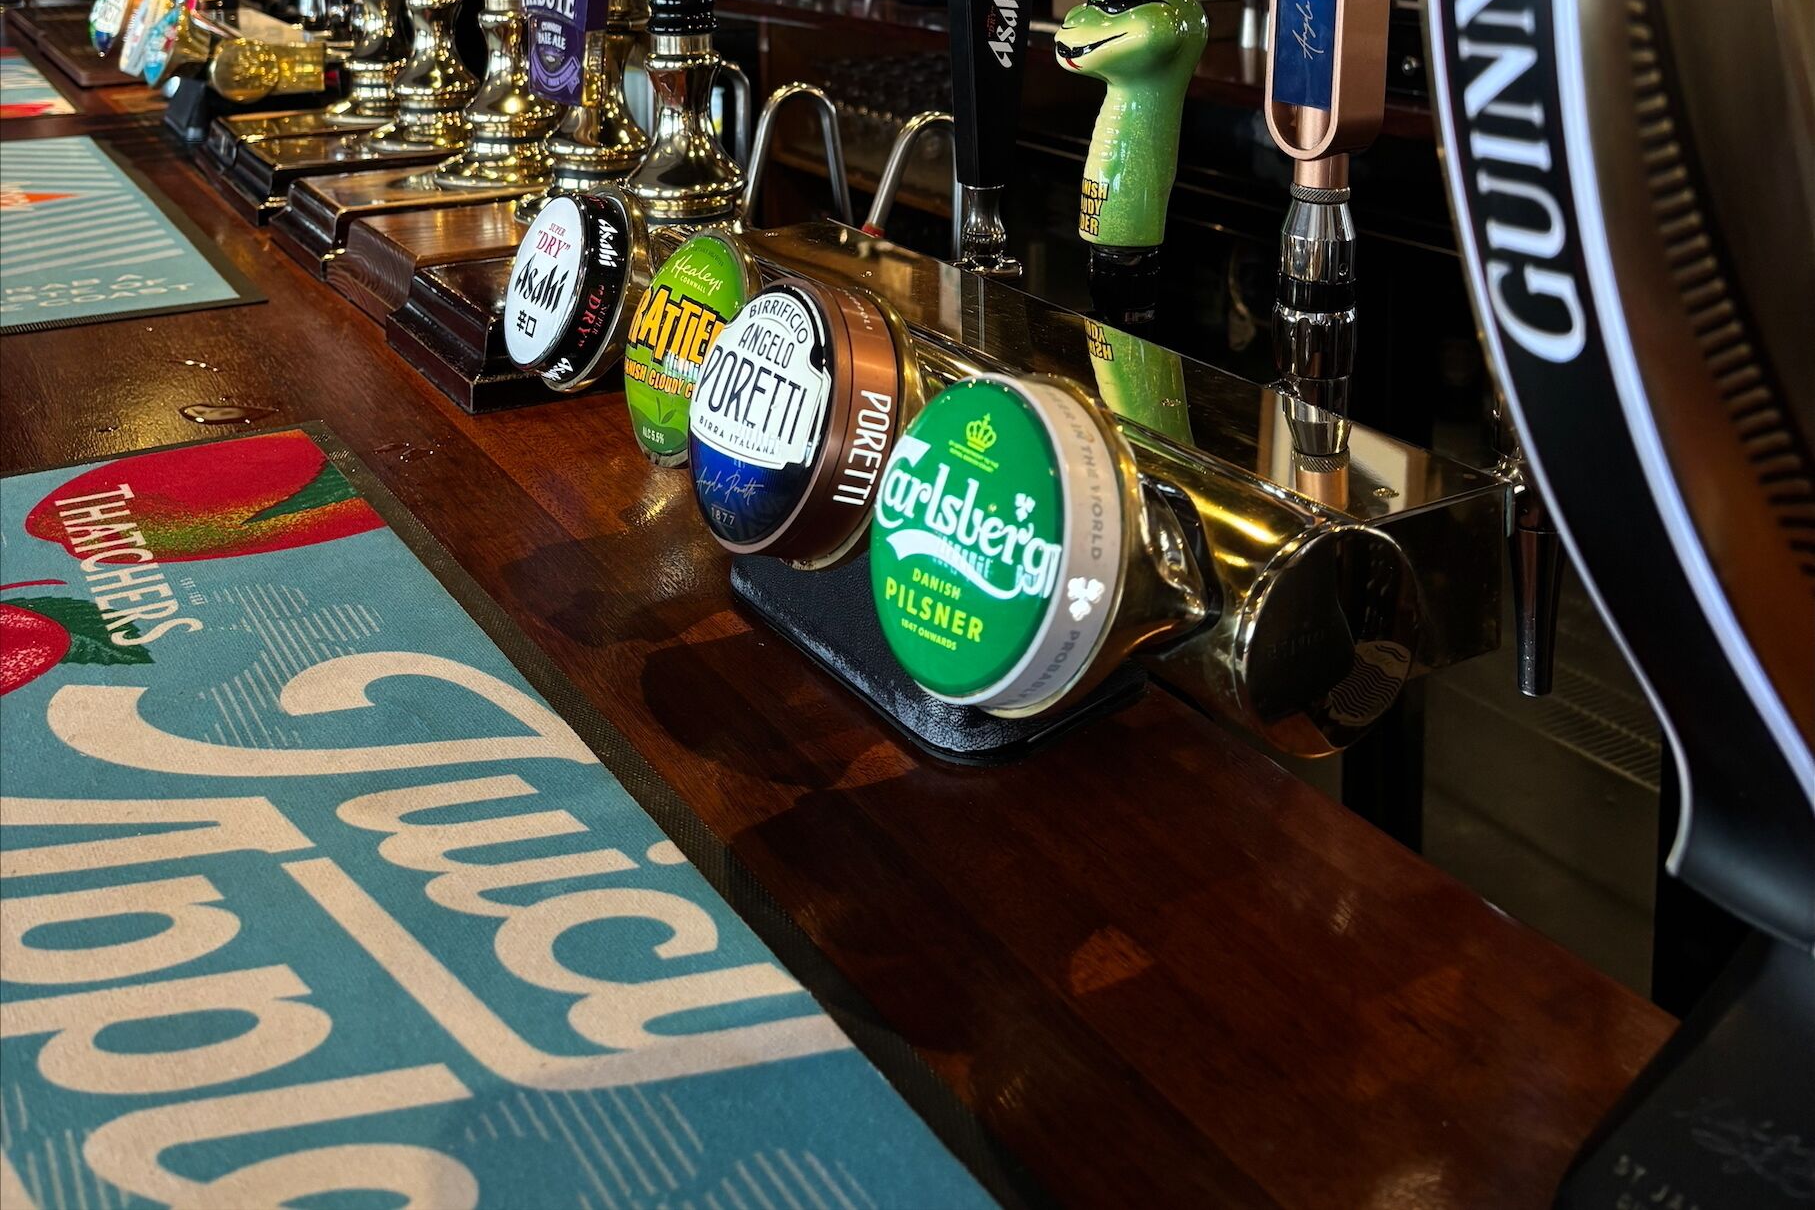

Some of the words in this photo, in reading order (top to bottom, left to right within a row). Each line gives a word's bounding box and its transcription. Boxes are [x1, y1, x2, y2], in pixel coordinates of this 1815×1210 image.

[598, 218, 619, 268] Asahi
[38, 282, 195, 308] COAST
[514, 252, 570, 314] Asahi
[670, 253, 724, 297] Healeys
[680, 275, 707, 294] CORNWALL
[738, 321, 795, 370] ANGELO
[749, 299, 809, 344] BIRRIFICIO
[648, 369, 685, 395] CLOUDY
[698, 344, 808, 446] PORETTI
[699, 415, 725, 439] BIRRA
[729, 433, 776, 456] ITALIANA
[832, 390, 893, 506] PORETTI
[710, 506, 736, 526] 1877
[875, 435, 1062, 599] Carlsberg
[1081, 445, 1099, 481] THE
[1090, 485, 1104, 561] WORLD
[54, 481, 205, 649] THATCHERS
[912, 567, 961, 601] DANISH
[885, 576, 984, 643] PILSNER
[917, 626, 957, 651] ONWARDS
[46, 651, 857, 1092] Juicy
